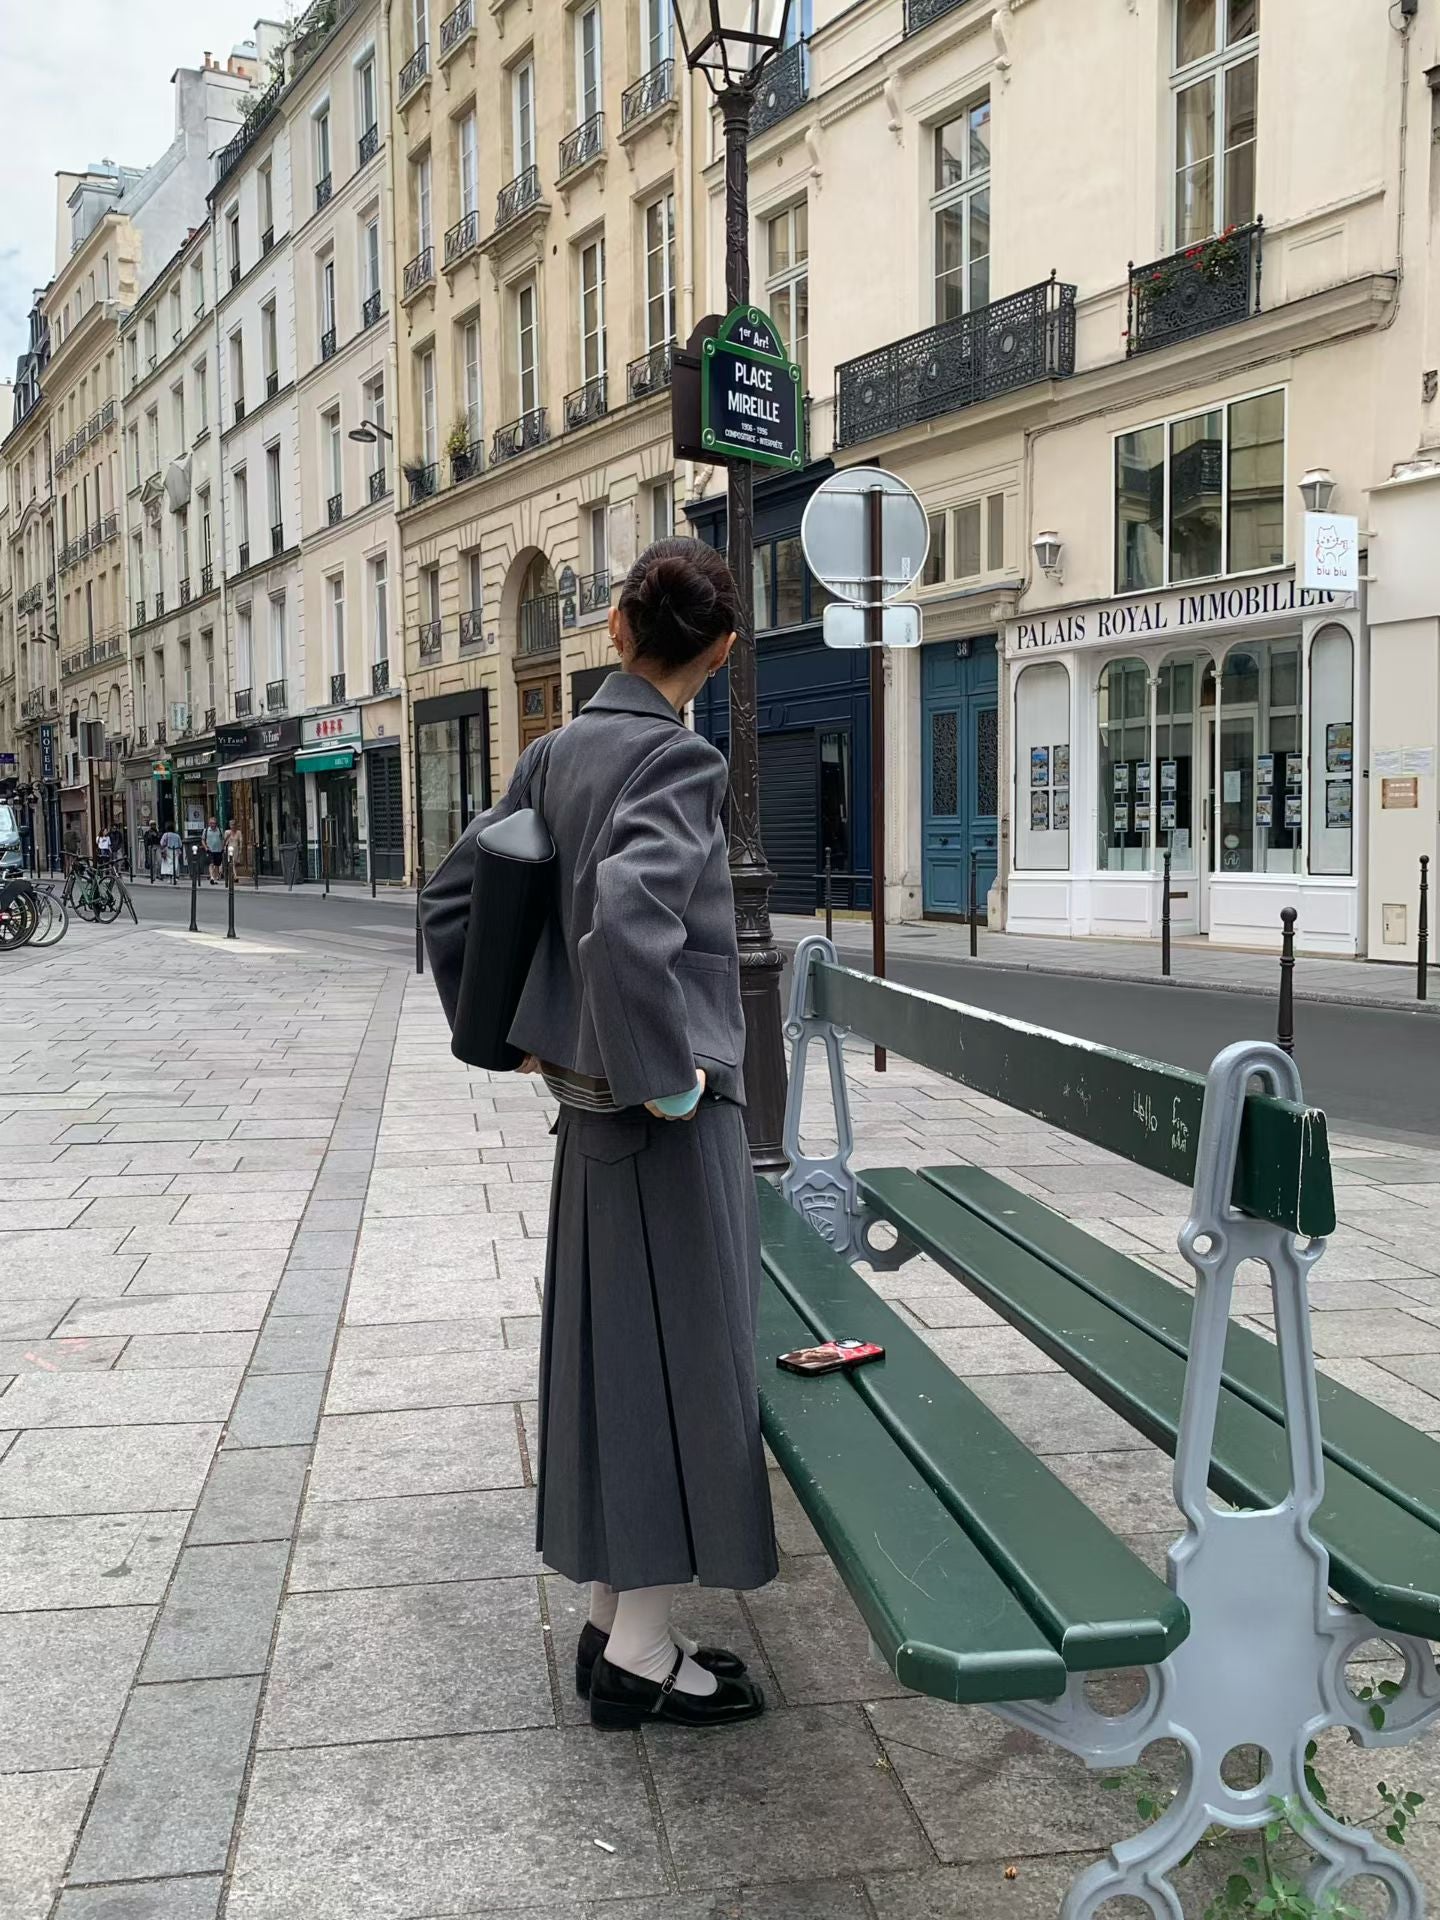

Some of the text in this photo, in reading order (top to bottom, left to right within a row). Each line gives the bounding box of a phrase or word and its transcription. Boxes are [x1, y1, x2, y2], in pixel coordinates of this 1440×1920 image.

[735, 361, 773, 392] PLACE
[728, 389, 780, 423] MIREILLE
[1016, 614, 1086, 650] PALAIS
[1098, 601, 1168, 638] ROYAL
[42, 729, 52, 772] HOTEL
[1132, 1089, 1158, 1132] Hello
